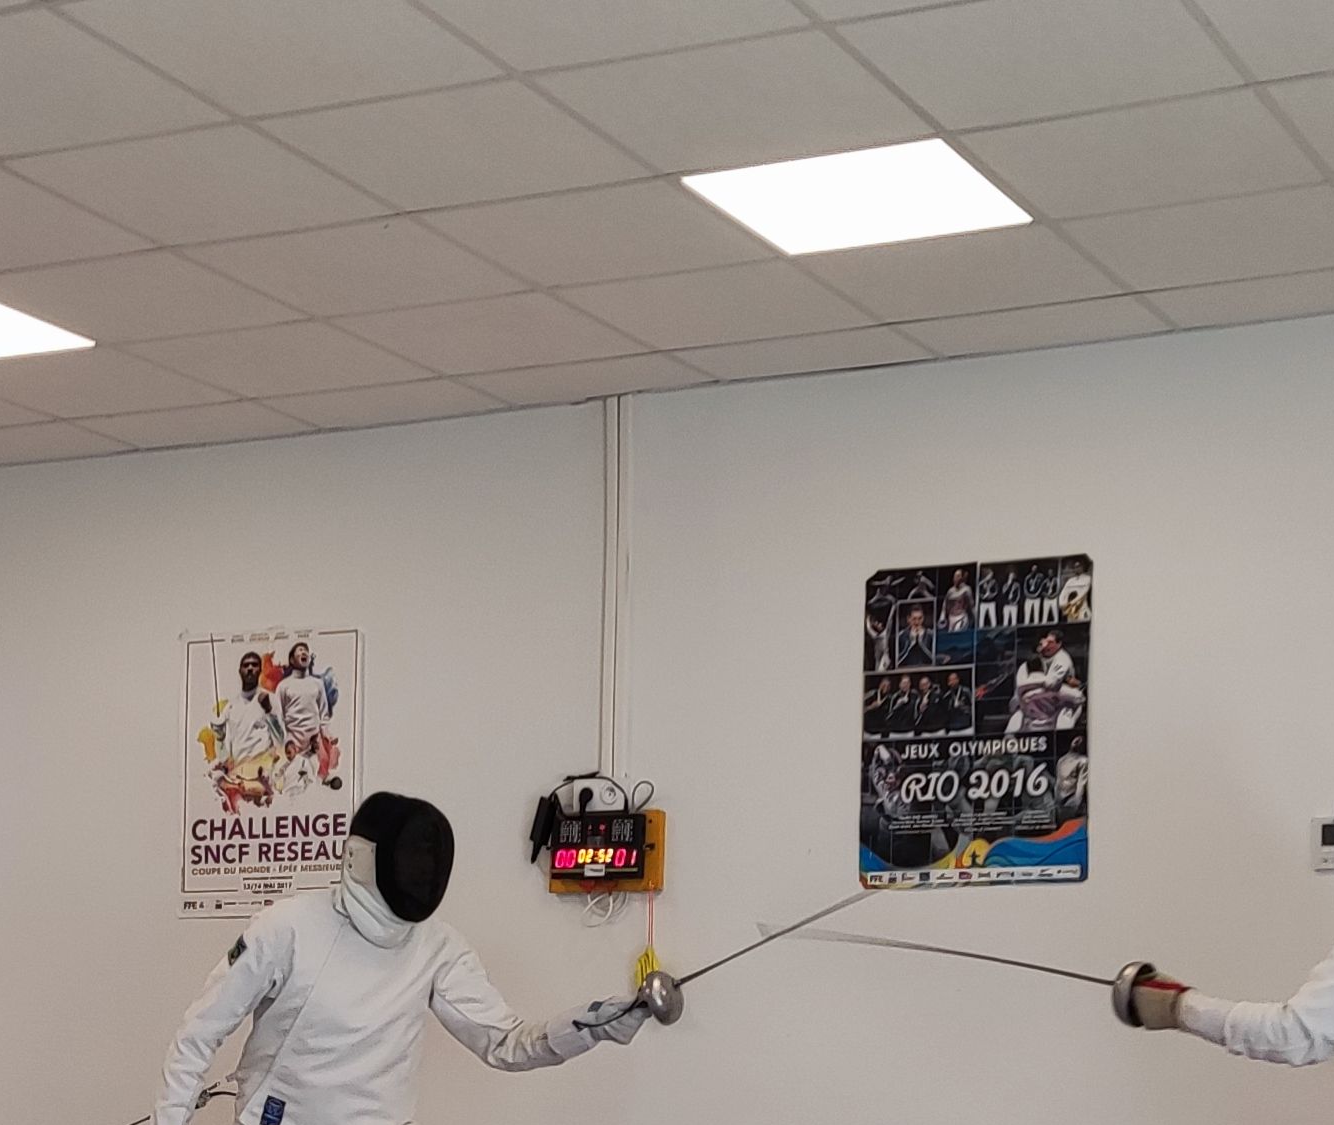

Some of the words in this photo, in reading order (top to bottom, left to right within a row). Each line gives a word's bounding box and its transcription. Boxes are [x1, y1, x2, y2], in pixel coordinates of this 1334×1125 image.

[900, 743, 940, 760] JEUX
[948, 735, 1047, 757] OLYMPIQUES
[900, 770, 960, 804] RIO
[967, 762, 1049, 800] 2016
[191, 813, 347, 842] CHALLENGE
[191, 843, 250, 866] SNCF
[258, 839, 347, 864] RESEAU
[554, 849, 577, 869] 00
[577, 848, 614, 864] 02:52
[614, 848, 637, 867] 01
[191, 867, 221, 876] COUPE
[223, 866, 236, 875] DU
[239, 865, 271, 875] MONDE
[300, 863, 342, 872] MESSIEUR
